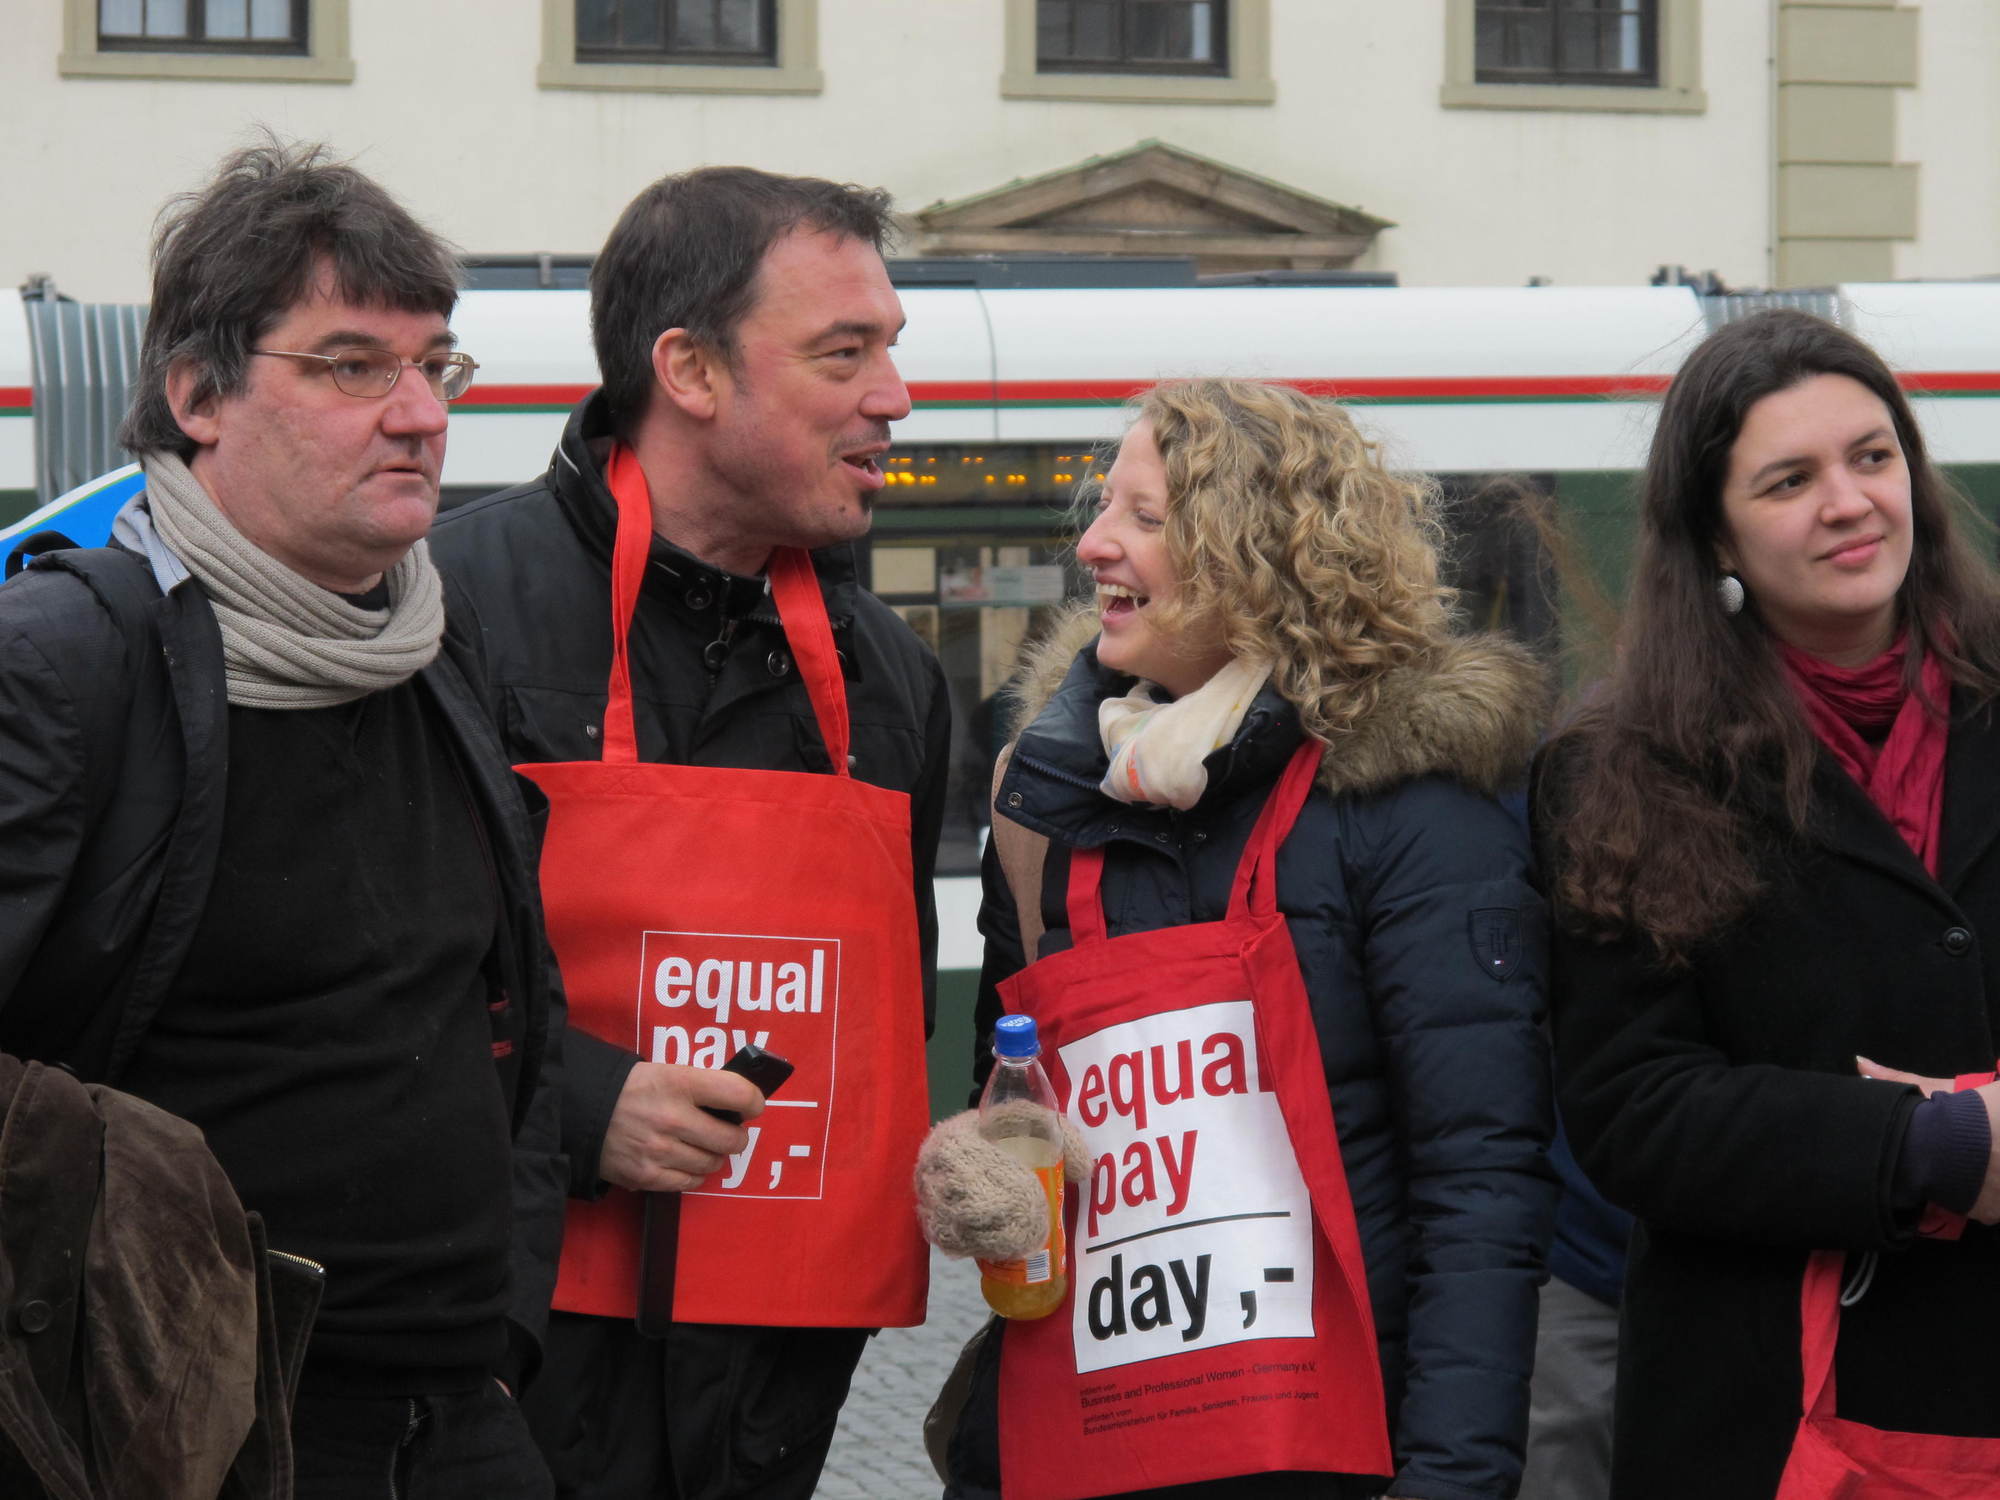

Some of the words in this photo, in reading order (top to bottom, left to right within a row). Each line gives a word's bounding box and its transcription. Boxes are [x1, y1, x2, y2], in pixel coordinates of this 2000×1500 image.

[654, 949, 825, 1024] equal
[1087, 1130, 1198, 1238] pay
[1088, 1253, 1212, 1342] day
[1081, 1392, 1122, 1409] Business
[1124, 1387, 1142, 1399] and
[1144, 1374, 1204, 1395] Professional
[1206, 1367, 1245, 1382] Women
[1252, 1361, 1300, 1375] Germany
[1274, 1390, 1293, 1400] und
